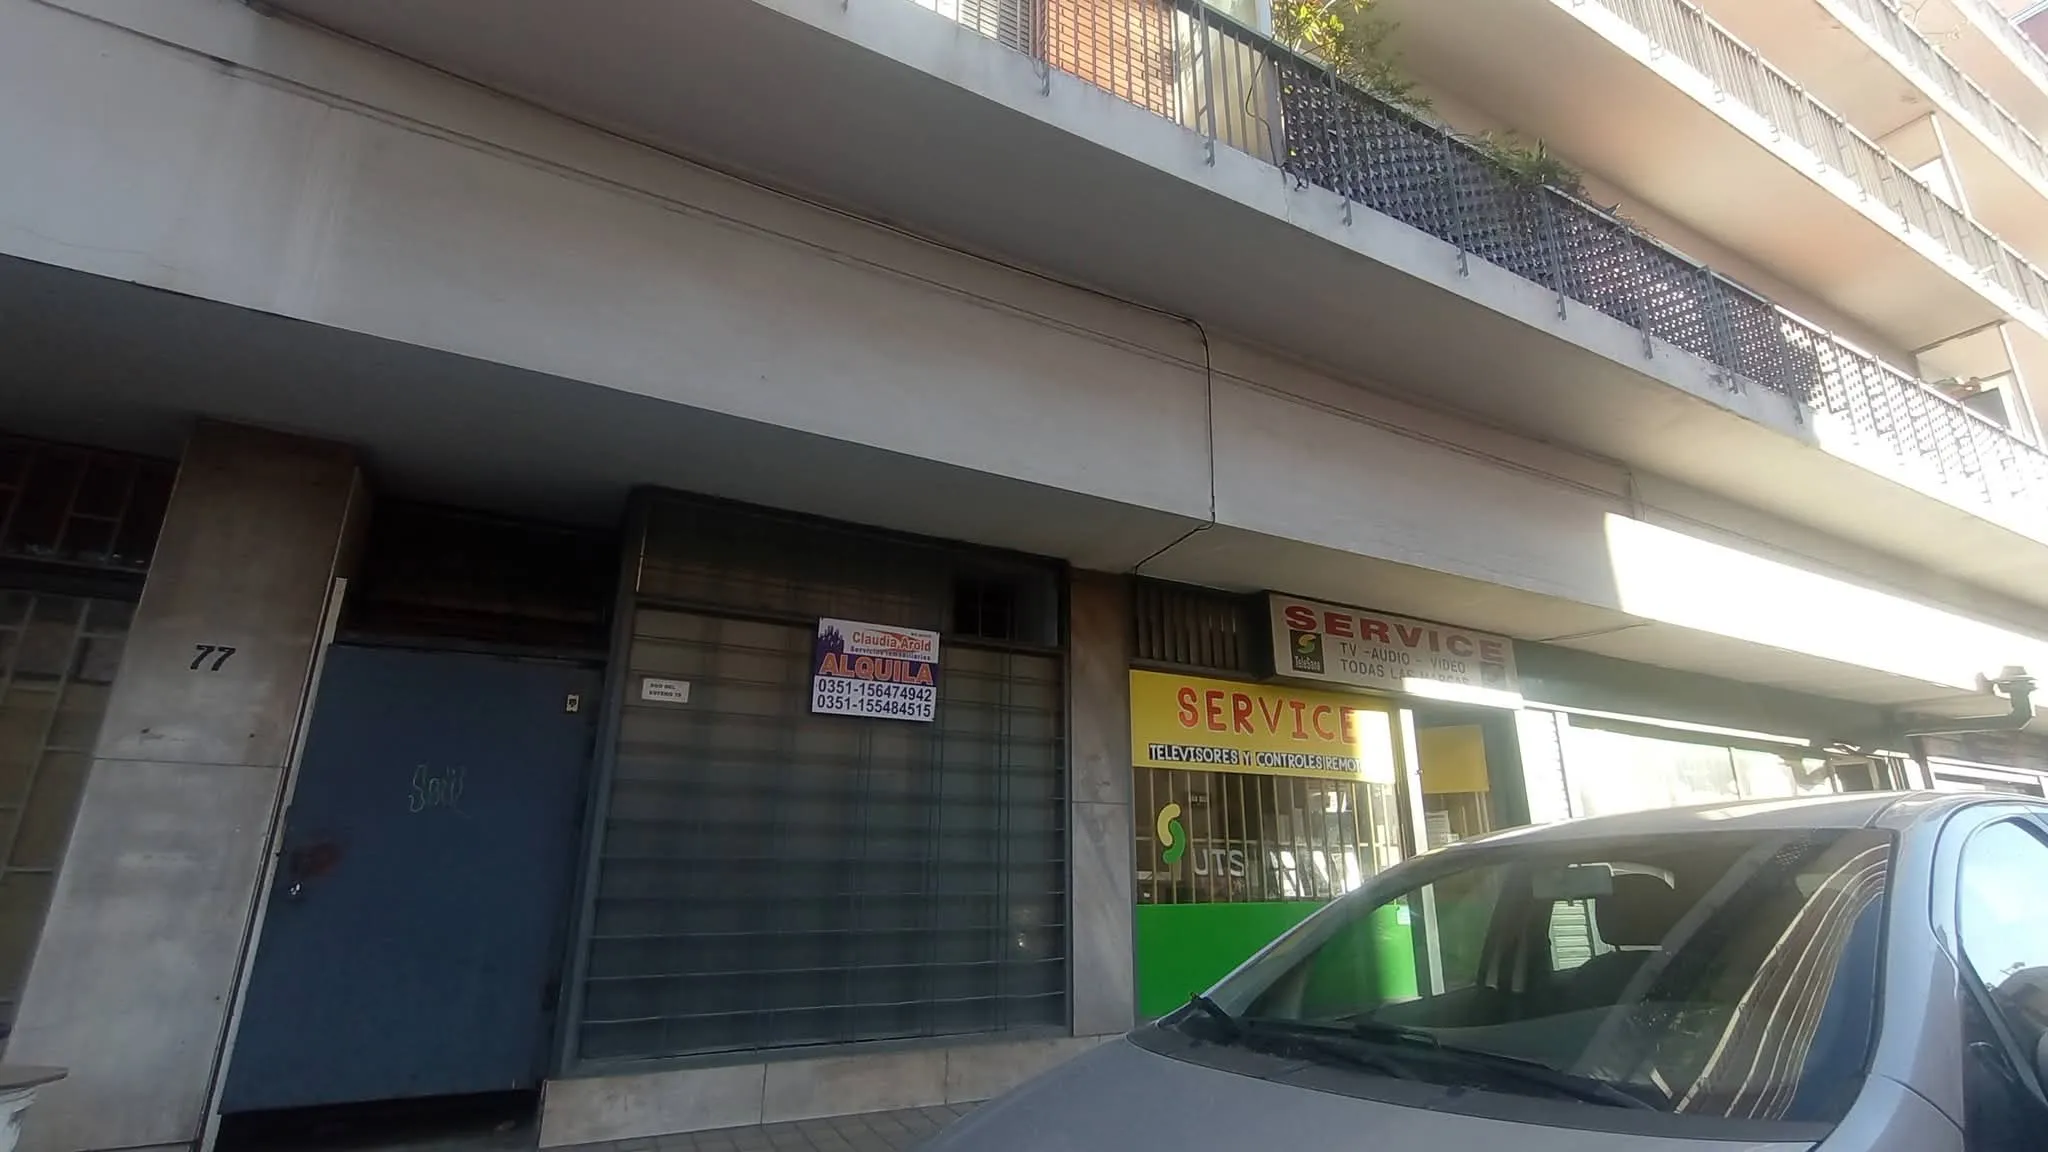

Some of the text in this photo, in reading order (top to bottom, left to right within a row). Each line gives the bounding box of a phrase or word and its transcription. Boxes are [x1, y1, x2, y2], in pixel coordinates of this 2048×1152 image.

[852, 631, 897, 649] Claudia
[900, 637, 932, 652] Arold
[1284, 605, 1505, 664] SERVICE
[190, 644, 236, 671] 77
[818, 652, 934, 686] ALQUILA
[1340, 642, 1358, 657] TV
[1430, 657, 1467, 675] VIDEO
[1340, 659, 1385, 678] TODAS
[818, 678, 932, 702] 0351-156474942
[817, 694, 931, 718] 0351-155484515
[1177, 686, 1357, 745] SERVICE
[1149, 744, 1362, 774] TELEVISORES Y CONTROLES REMOT
[1192, 849, 1246, 877] UTS
